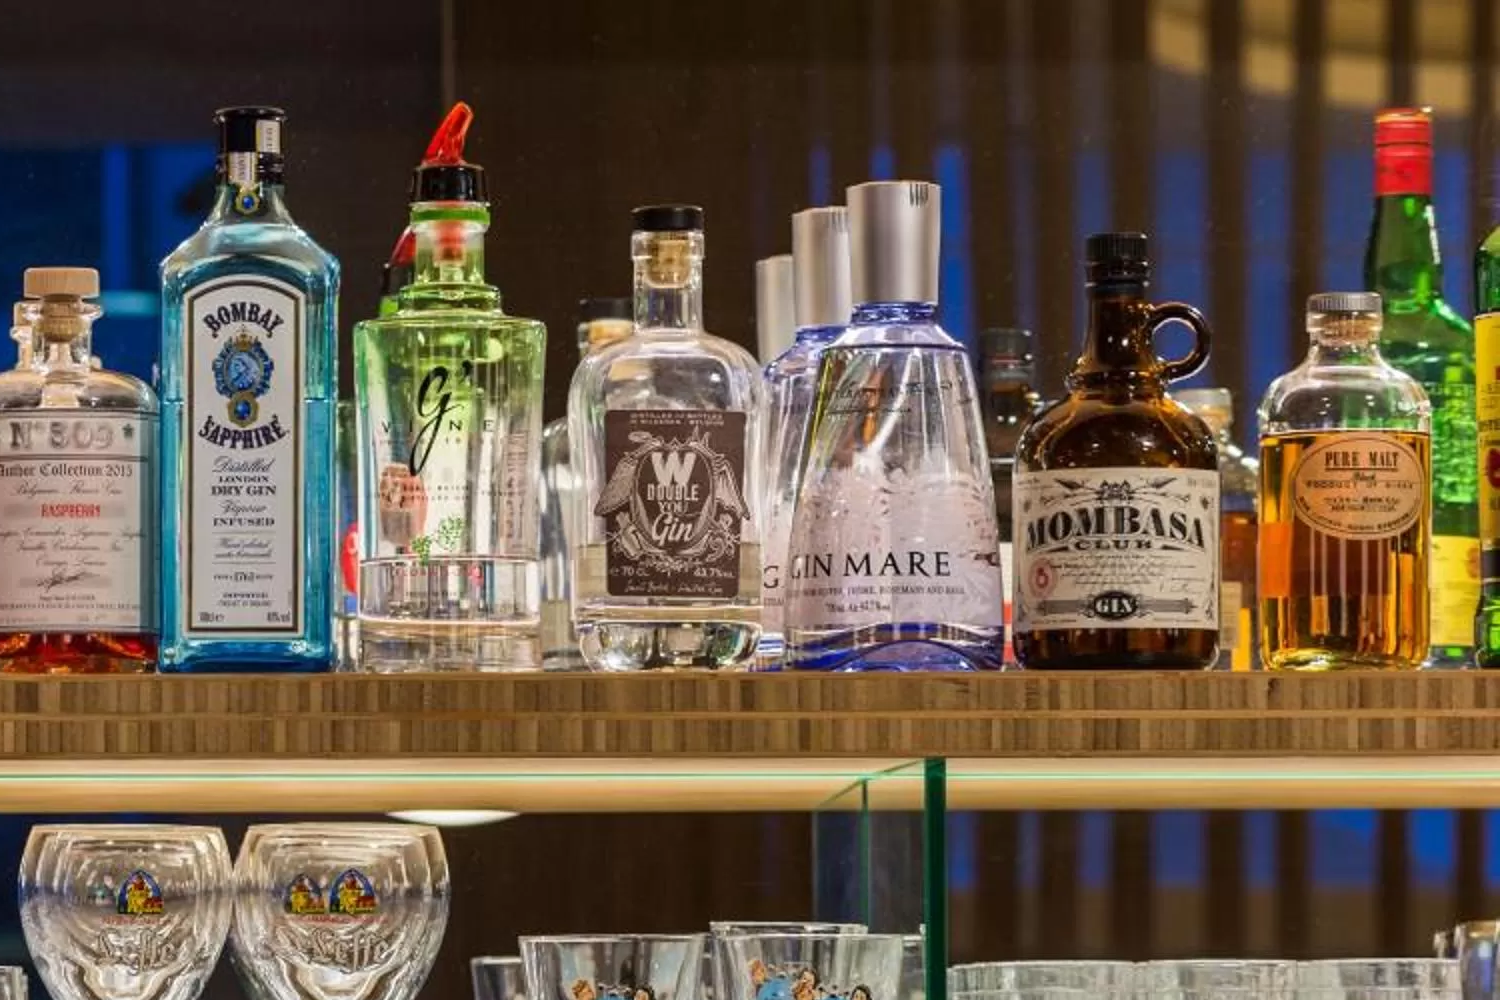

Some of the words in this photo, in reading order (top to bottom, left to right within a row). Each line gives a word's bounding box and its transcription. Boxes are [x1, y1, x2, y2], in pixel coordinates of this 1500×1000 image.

[202, 301, 285, 338] BOMBAY
[198, 414, 286, 449] SAPPHIRE
[1325, 451, 1360, 467] PURE
[1368, 451, 1399, 467] MALT
[39, 463, 102, 478] Collection
[651, 450, 698, 487] W
[211, 485, 245, 496] DRY
[246, 485, 277, 496] GIN
[647, 484, 700, 500] DOUBLE
[213, 517, 275, 527] INFUSED
[651, 514, 694, 546] Gin
[1027, 505, 1205, 551] MOMBASA
[1073, 539, 1152, 549] CLUB
[842, 551, 951, 577] MARE
[1094, 598, 1136, 614] GIN
